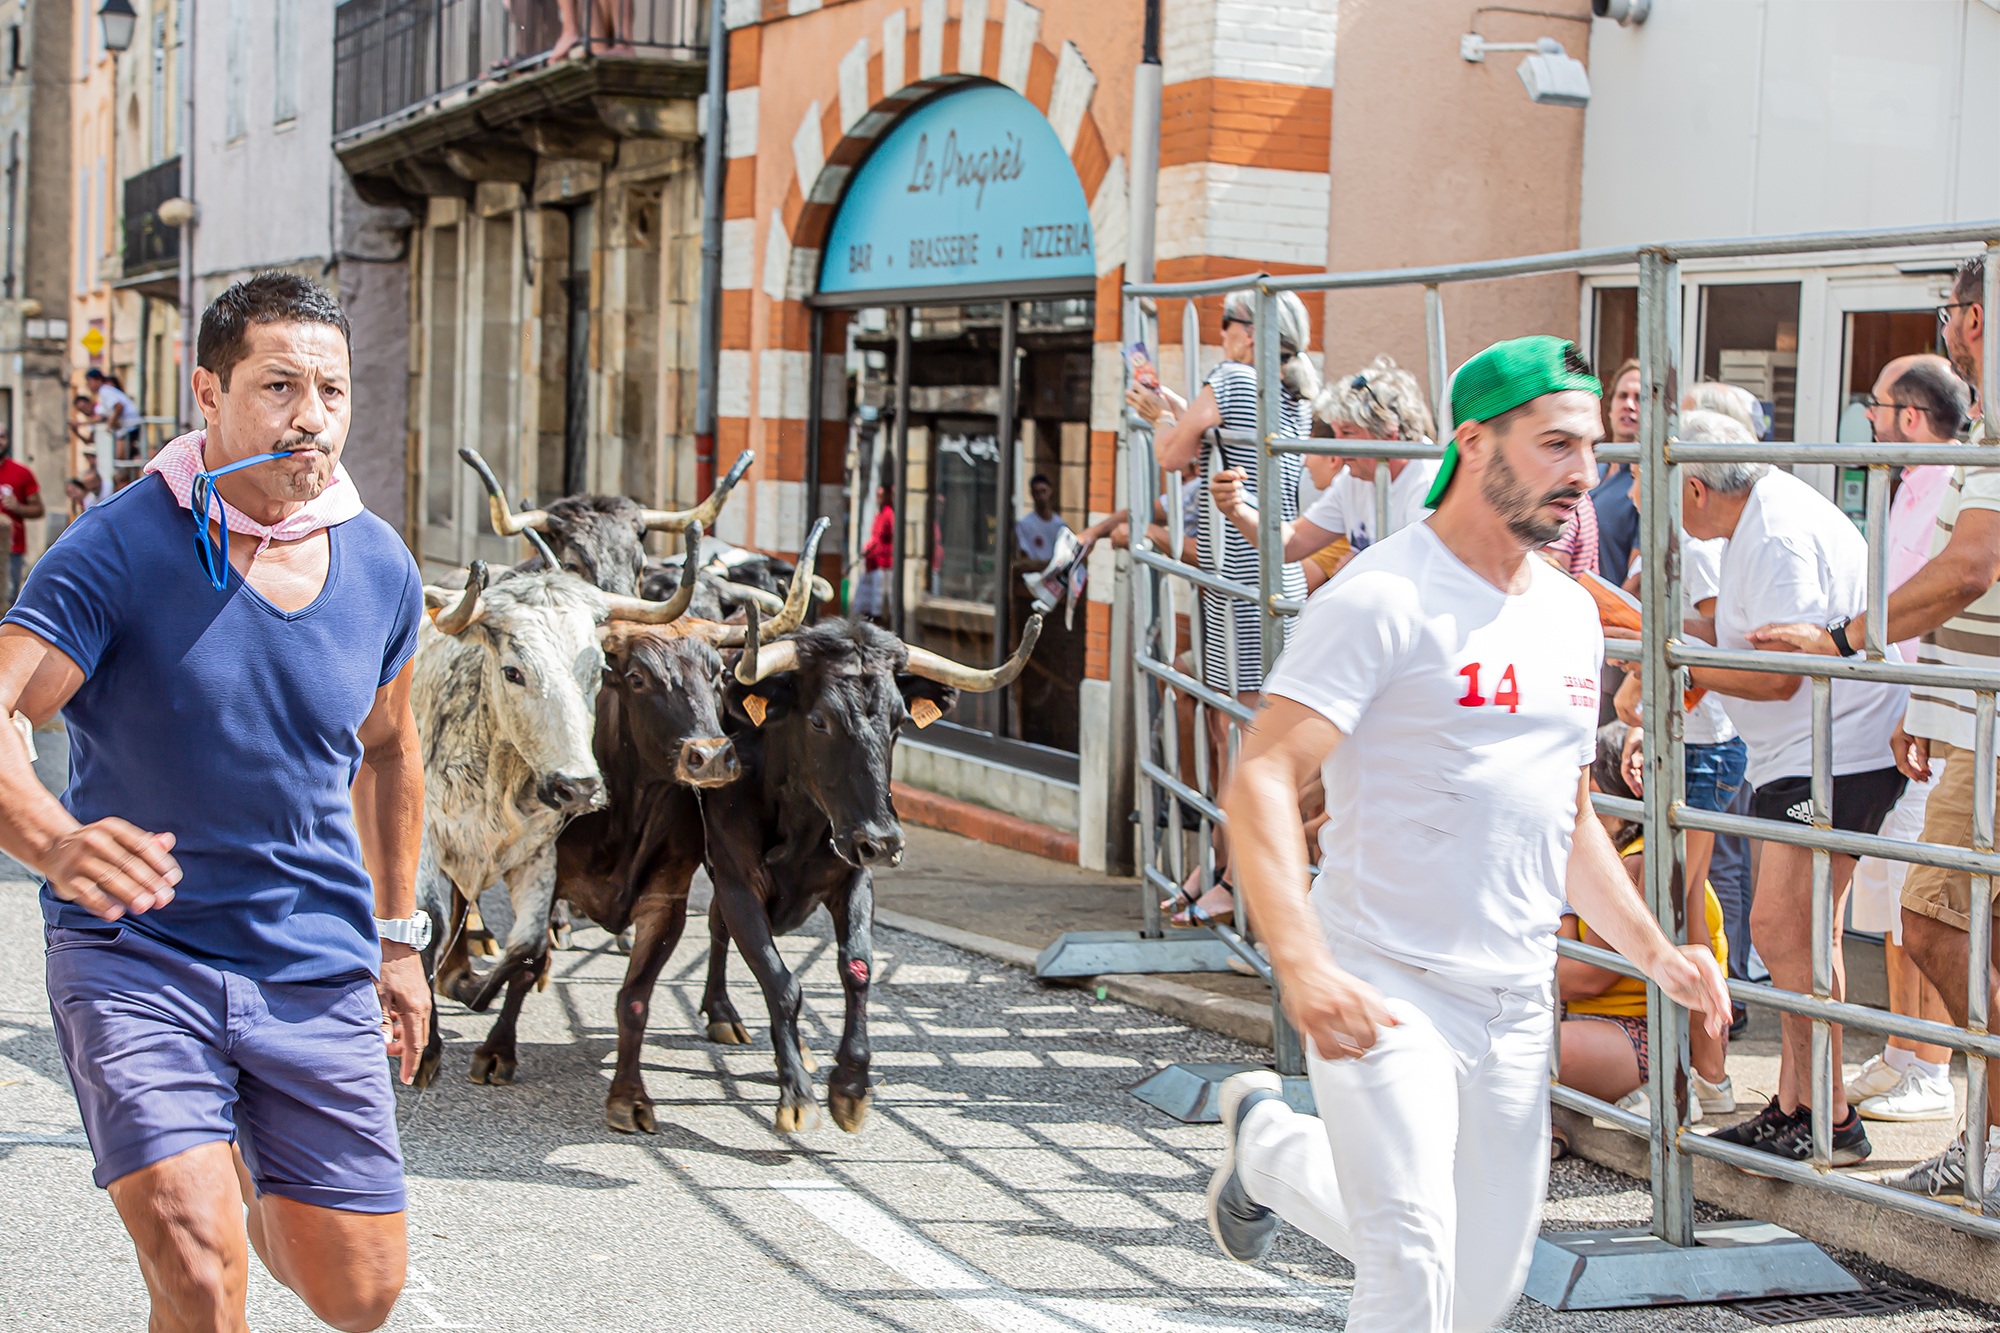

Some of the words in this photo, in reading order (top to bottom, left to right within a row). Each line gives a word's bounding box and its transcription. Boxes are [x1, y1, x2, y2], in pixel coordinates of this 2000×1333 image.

[907, 133, 935, 193] Le
[939, 129, 1025, 210] Progrès
[849, 243, 872, 274] BAR
[908, 233, 979, 269] BRASSERIE
[1021, 222, 1091, 259] PIZZERIA
[1458, 661, 1520, 714] 14
